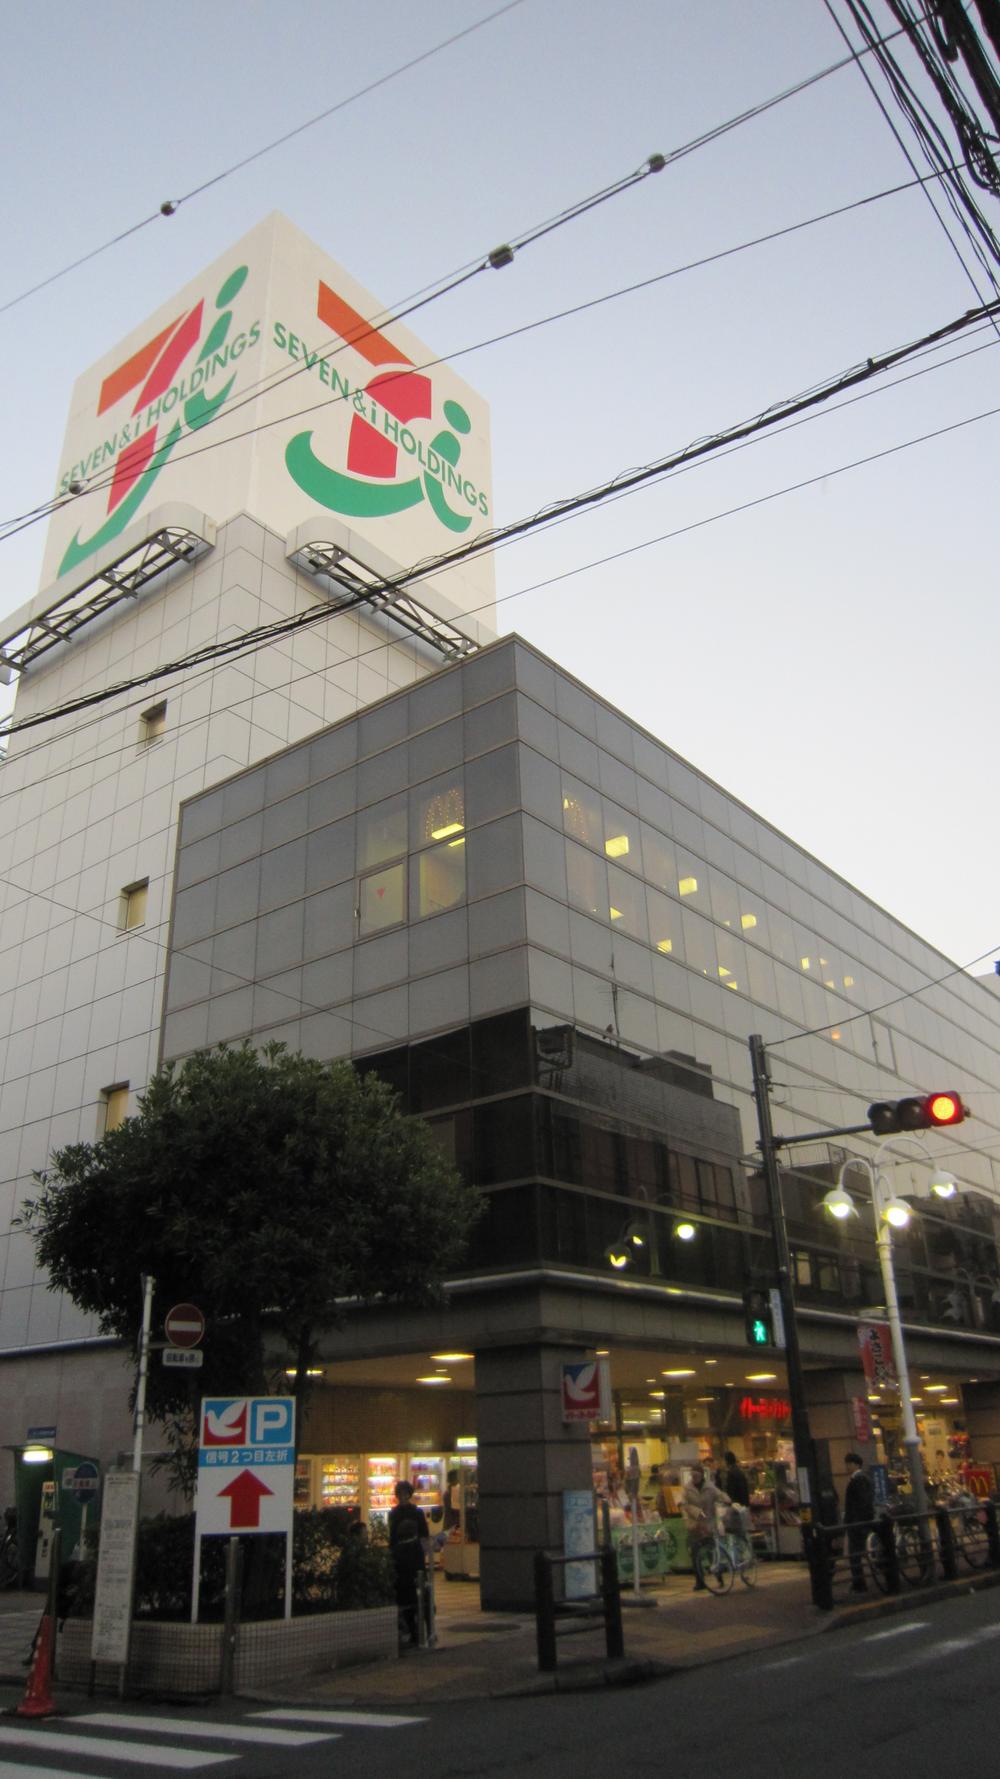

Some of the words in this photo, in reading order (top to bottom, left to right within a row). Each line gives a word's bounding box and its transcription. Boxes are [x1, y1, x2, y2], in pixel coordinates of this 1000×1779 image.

[146, 320, 261, 428] HOLDINGS
[384, 412, 489, 517] HOLDINGS
[256, 1404, 288, 1441] P
